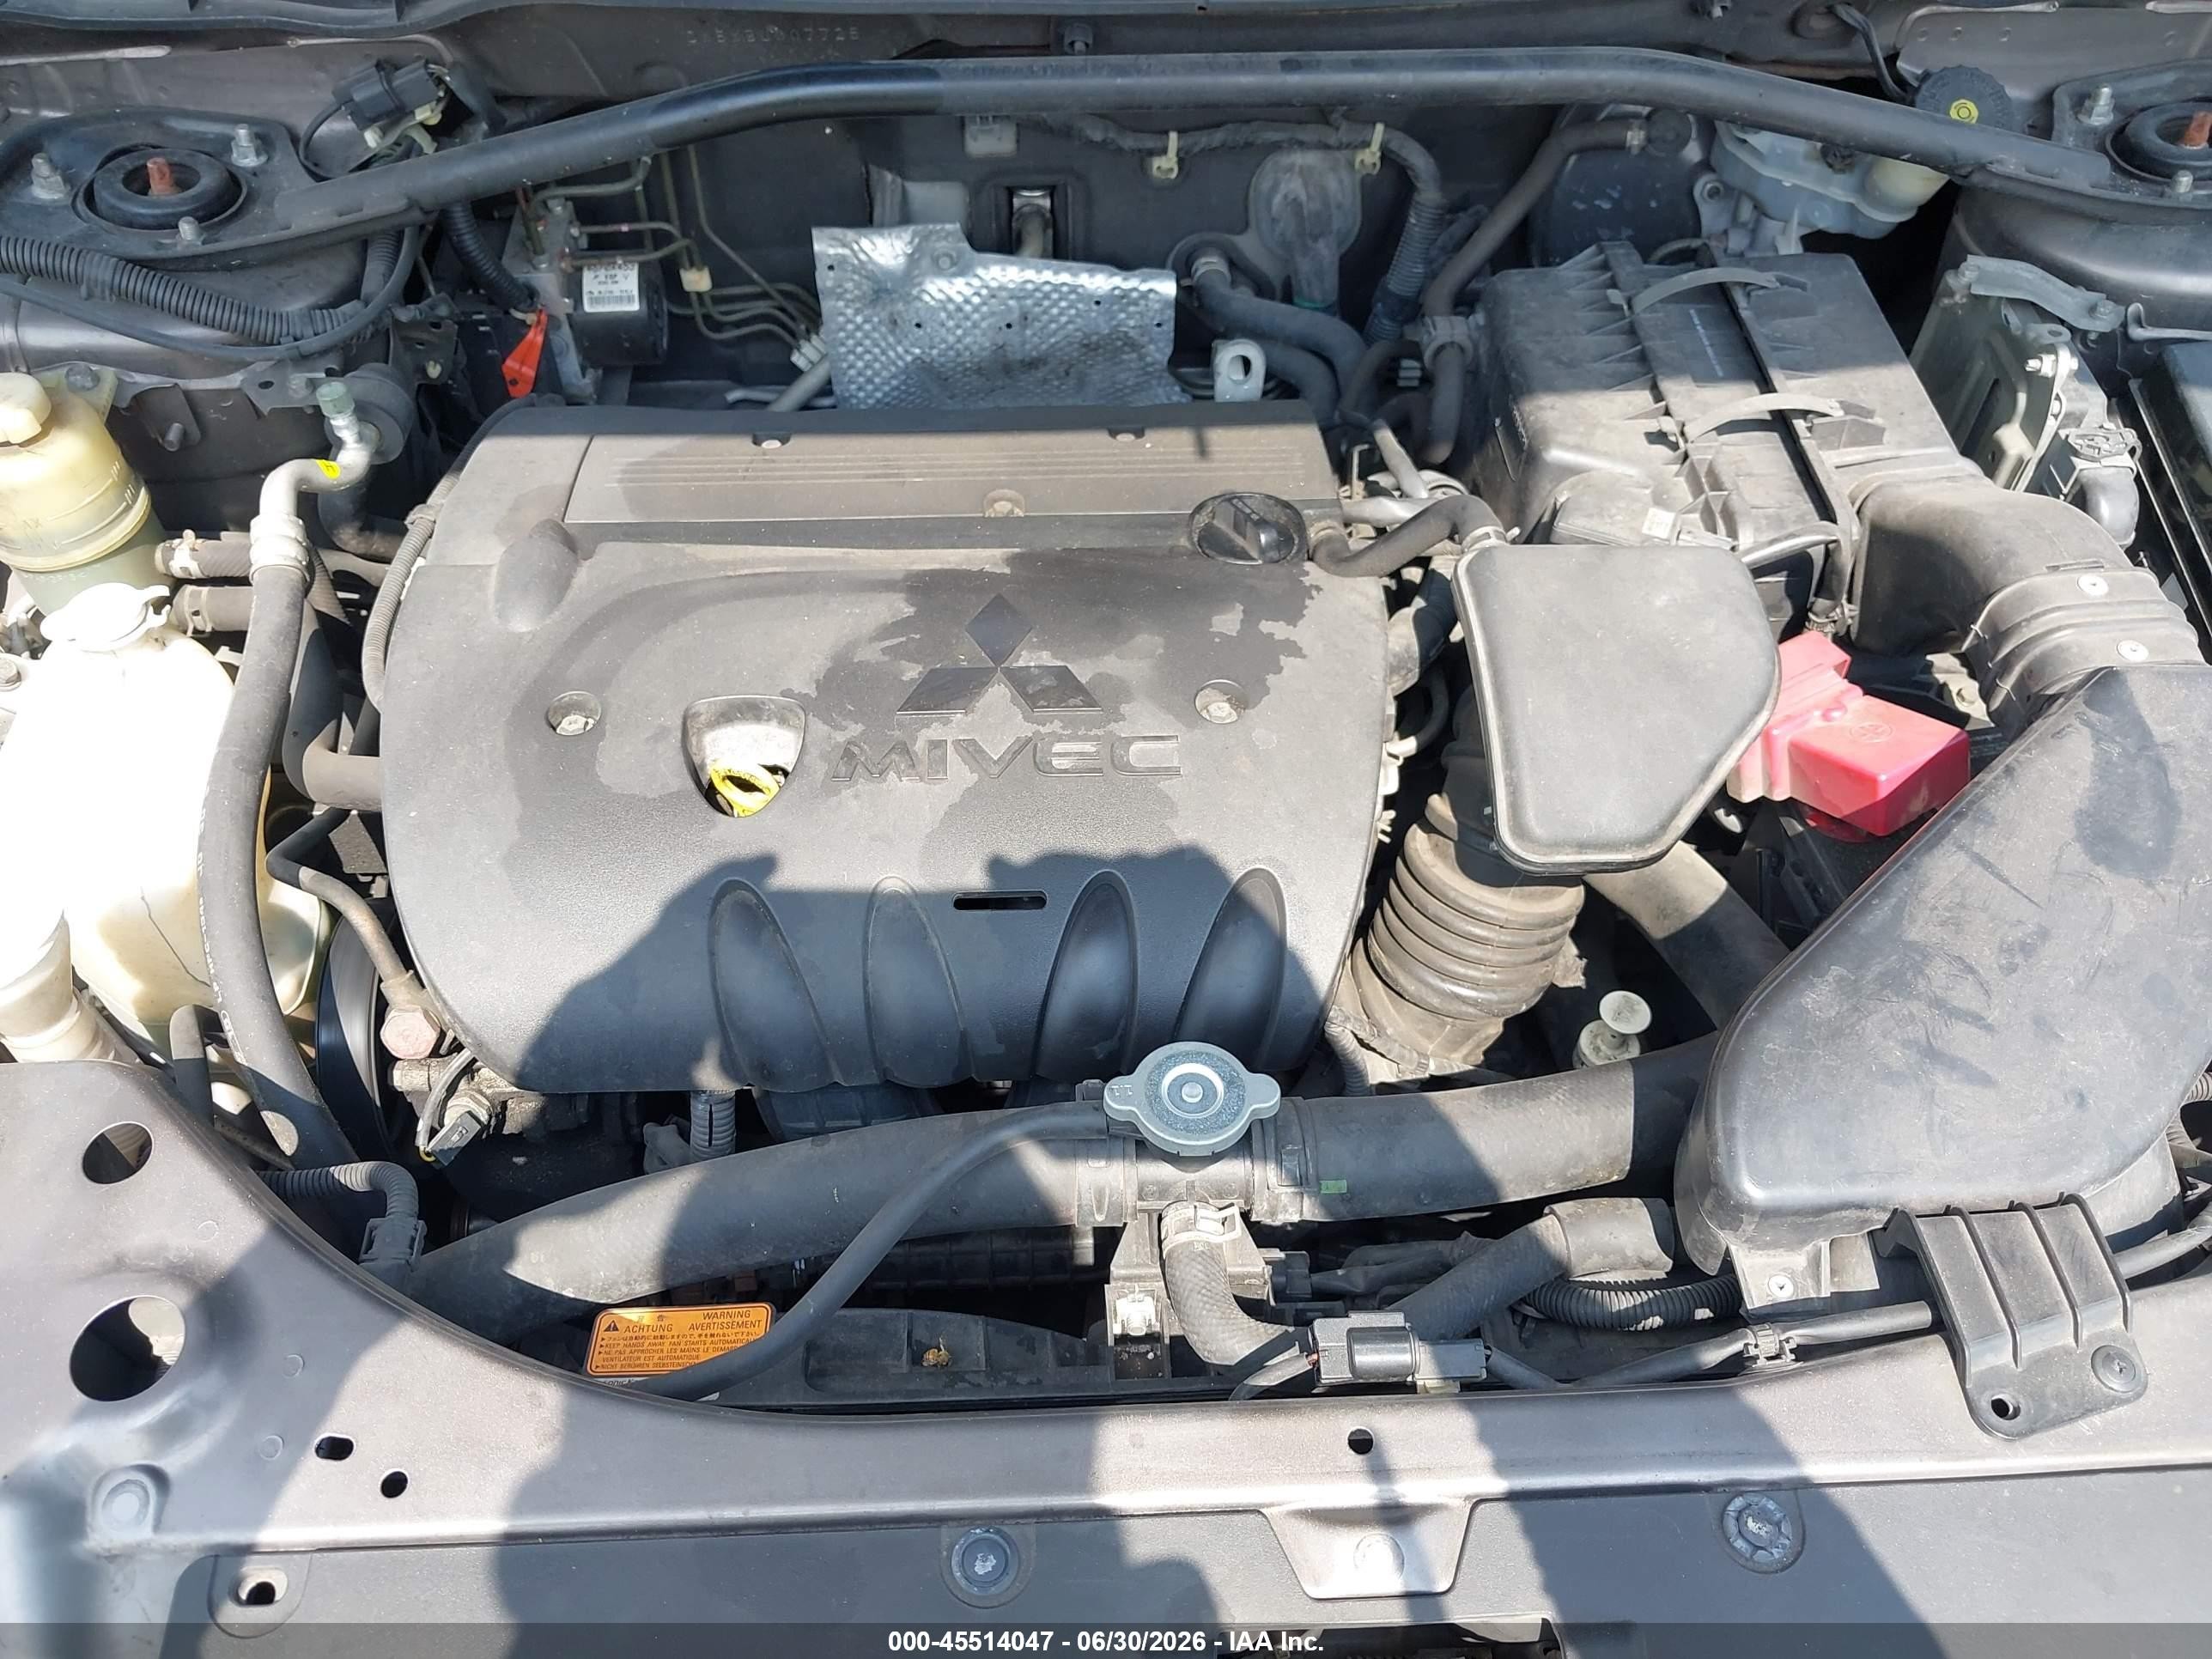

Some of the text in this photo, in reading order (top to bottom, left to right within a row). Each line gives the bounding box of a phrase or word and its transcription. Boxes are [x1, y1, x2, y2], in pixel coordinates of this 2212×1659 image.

[831, 735, 1182, 782] MIVEC
[702, 1310, 751, 1320] WARNING
[623, 1323, 673, 1334] ACHTUNG
[688, 1319, 763, 1331] AVERTISSEMENT
